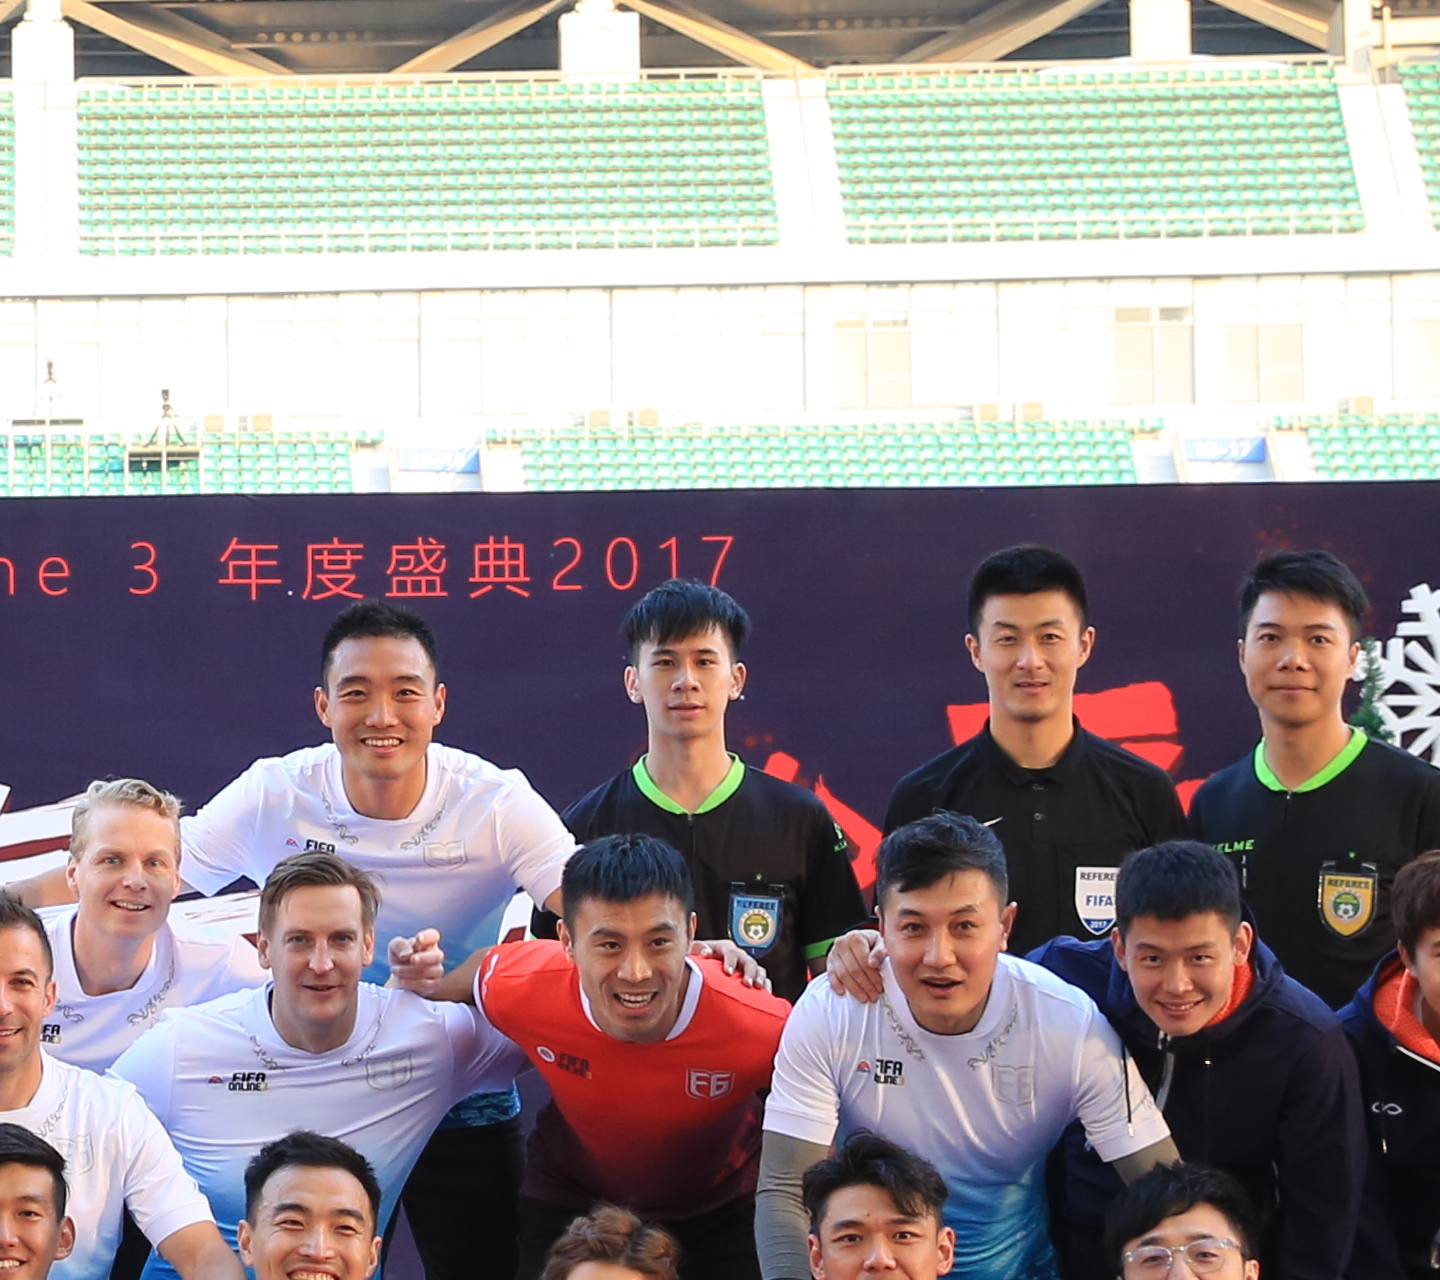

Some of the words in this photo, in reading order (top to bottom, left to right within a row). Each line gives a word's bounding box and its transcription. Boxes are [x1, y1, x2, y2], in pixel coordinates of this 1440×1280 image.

[127, 541, 159, 598] 3
[218, 535, 737, 603] 年度盛典2017
[1080, 872, 1118, 881] REFERE
[1085, 895, 1113, 907] FIFA
[43, 1024, 61, 1035] FA
[232, 1072, 266, 1083] FIFA
[228, 1081, 261, 1091] ONLINE
